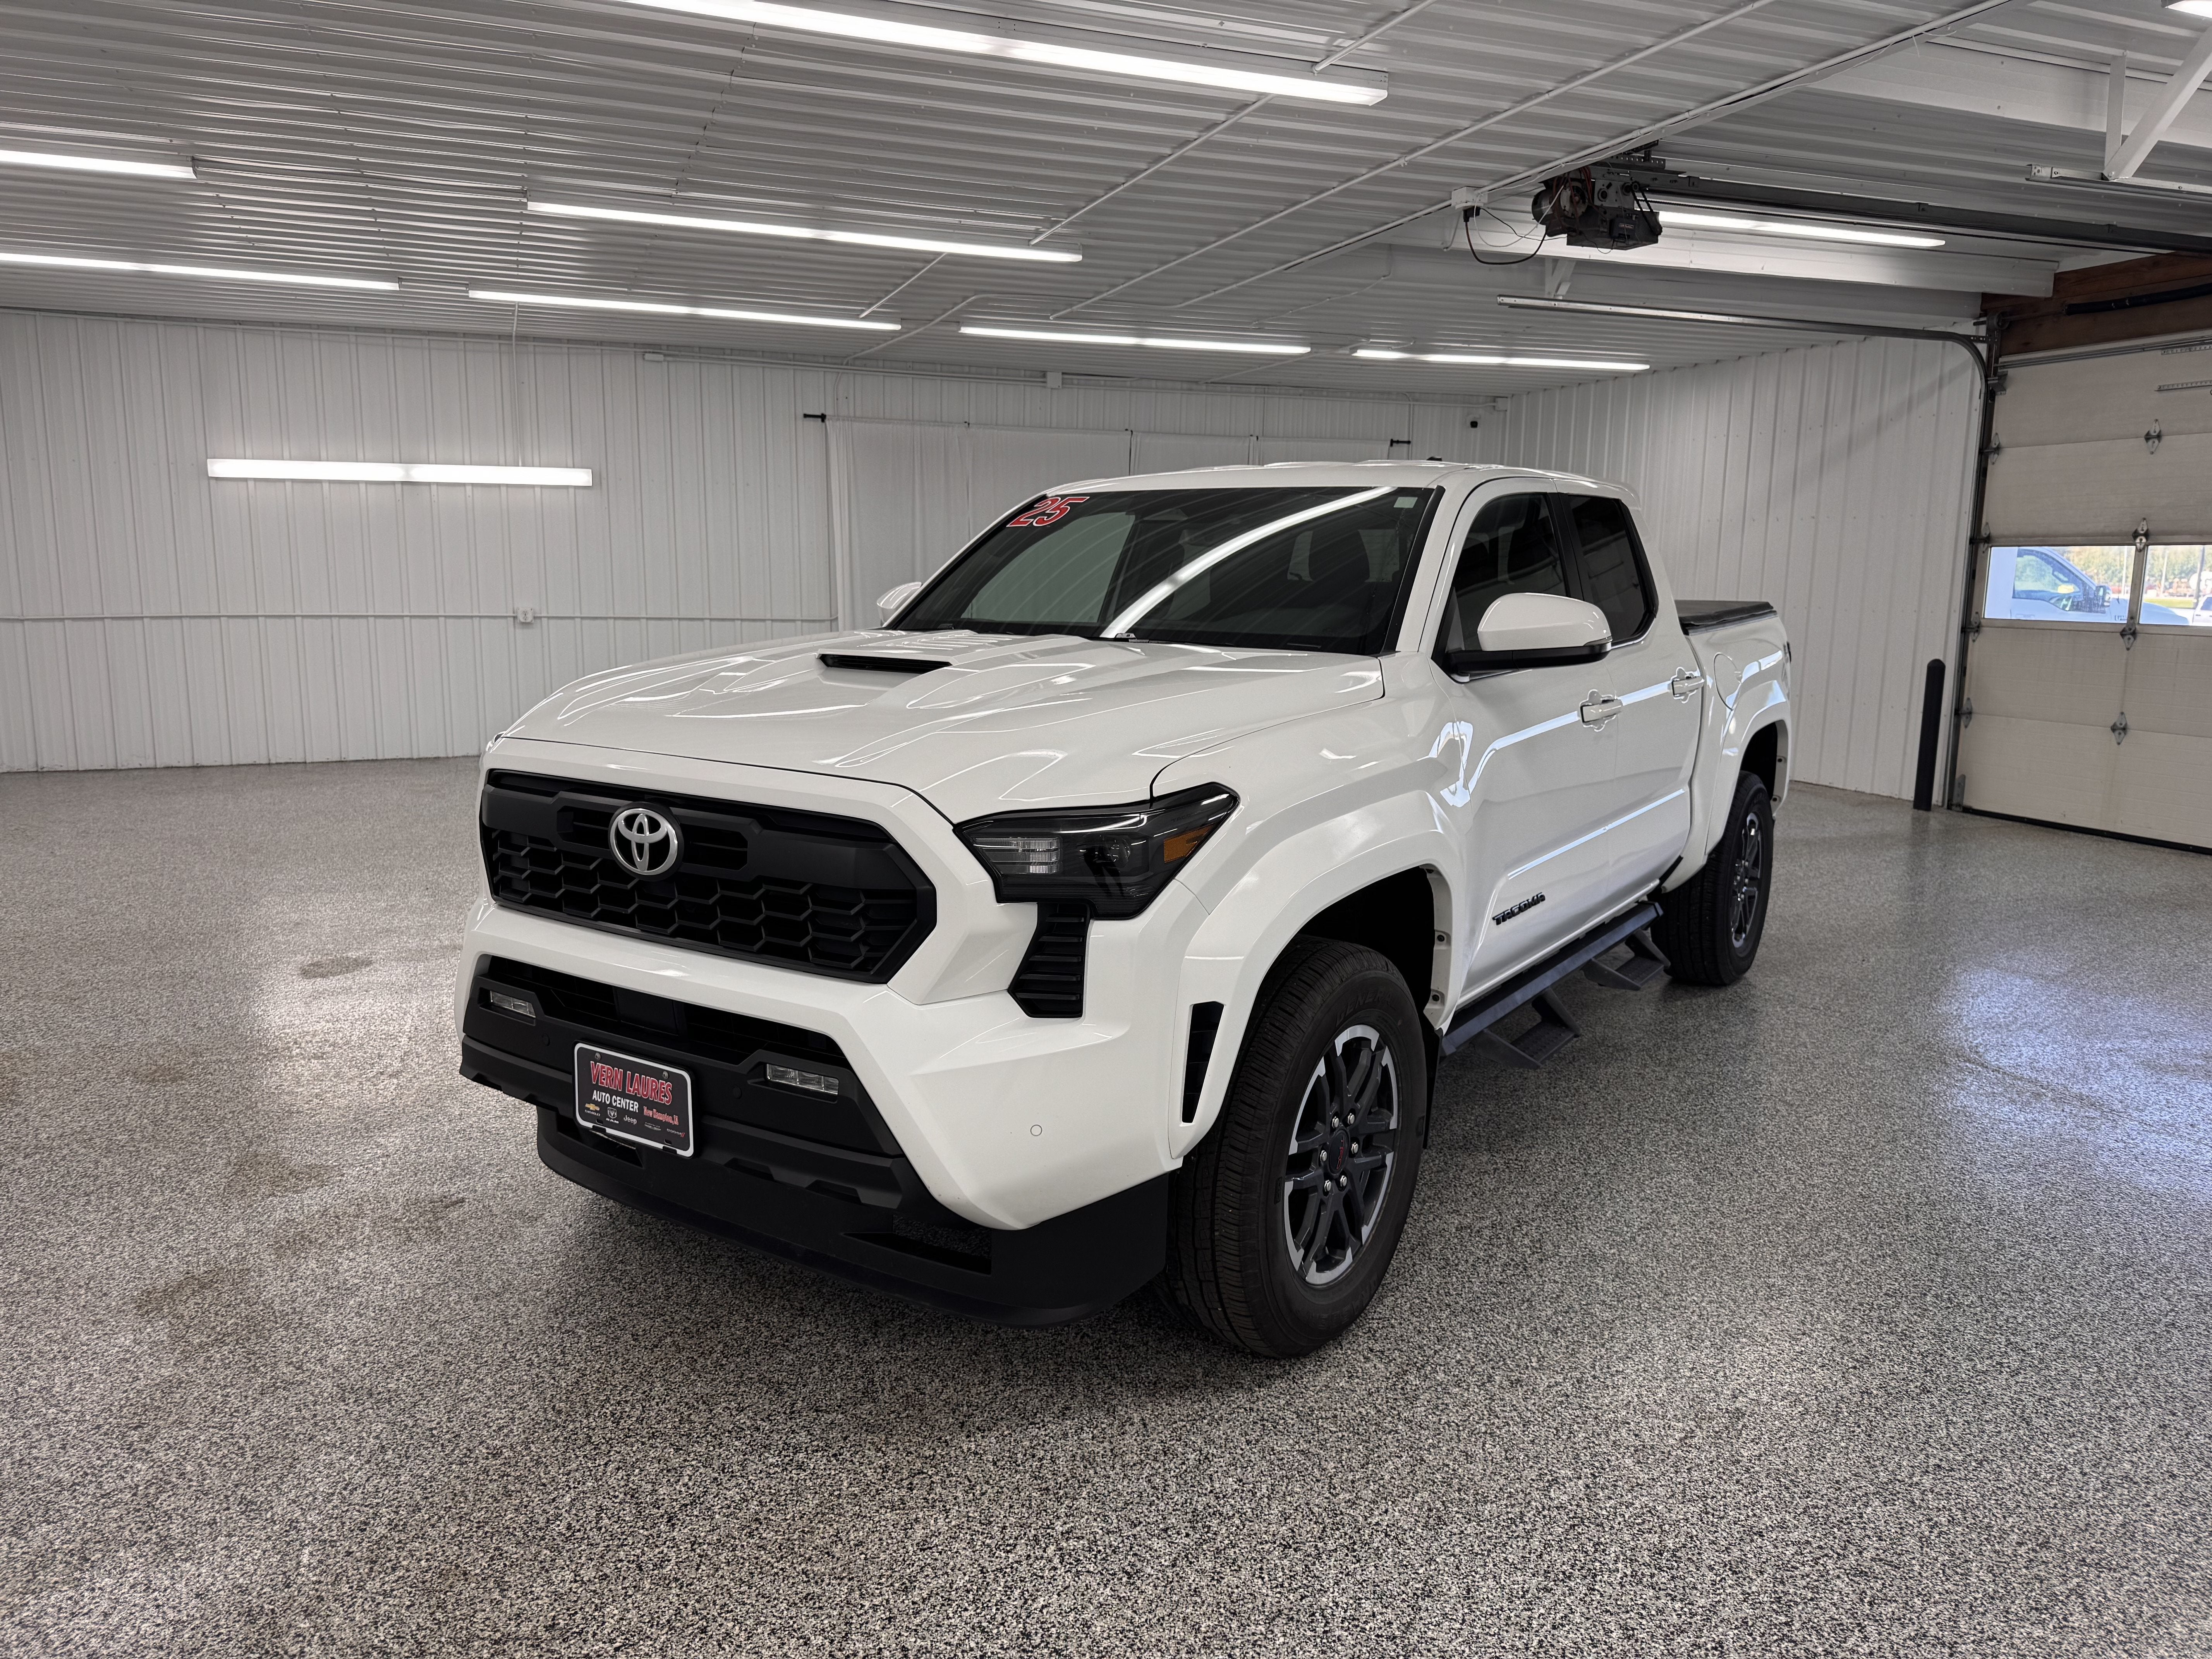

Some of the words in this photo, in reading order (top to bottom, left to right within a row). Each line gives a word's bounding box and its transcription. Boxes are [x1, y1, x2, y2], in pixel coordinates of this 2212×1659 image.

[1006, 496, 1090, 527] 25
[1492, 892, 1546, 925] TACOMA
[590, 1061, 623, 1091] VERN
[626, 1071, 672, 1105] LAURES
[592, 1090, 611, 1105] AUTO
[612, 1096, 639, 1113] CENTER
[644, 1106, 653, 1117] New
[623, 1115, 637, 1125] Jeep
